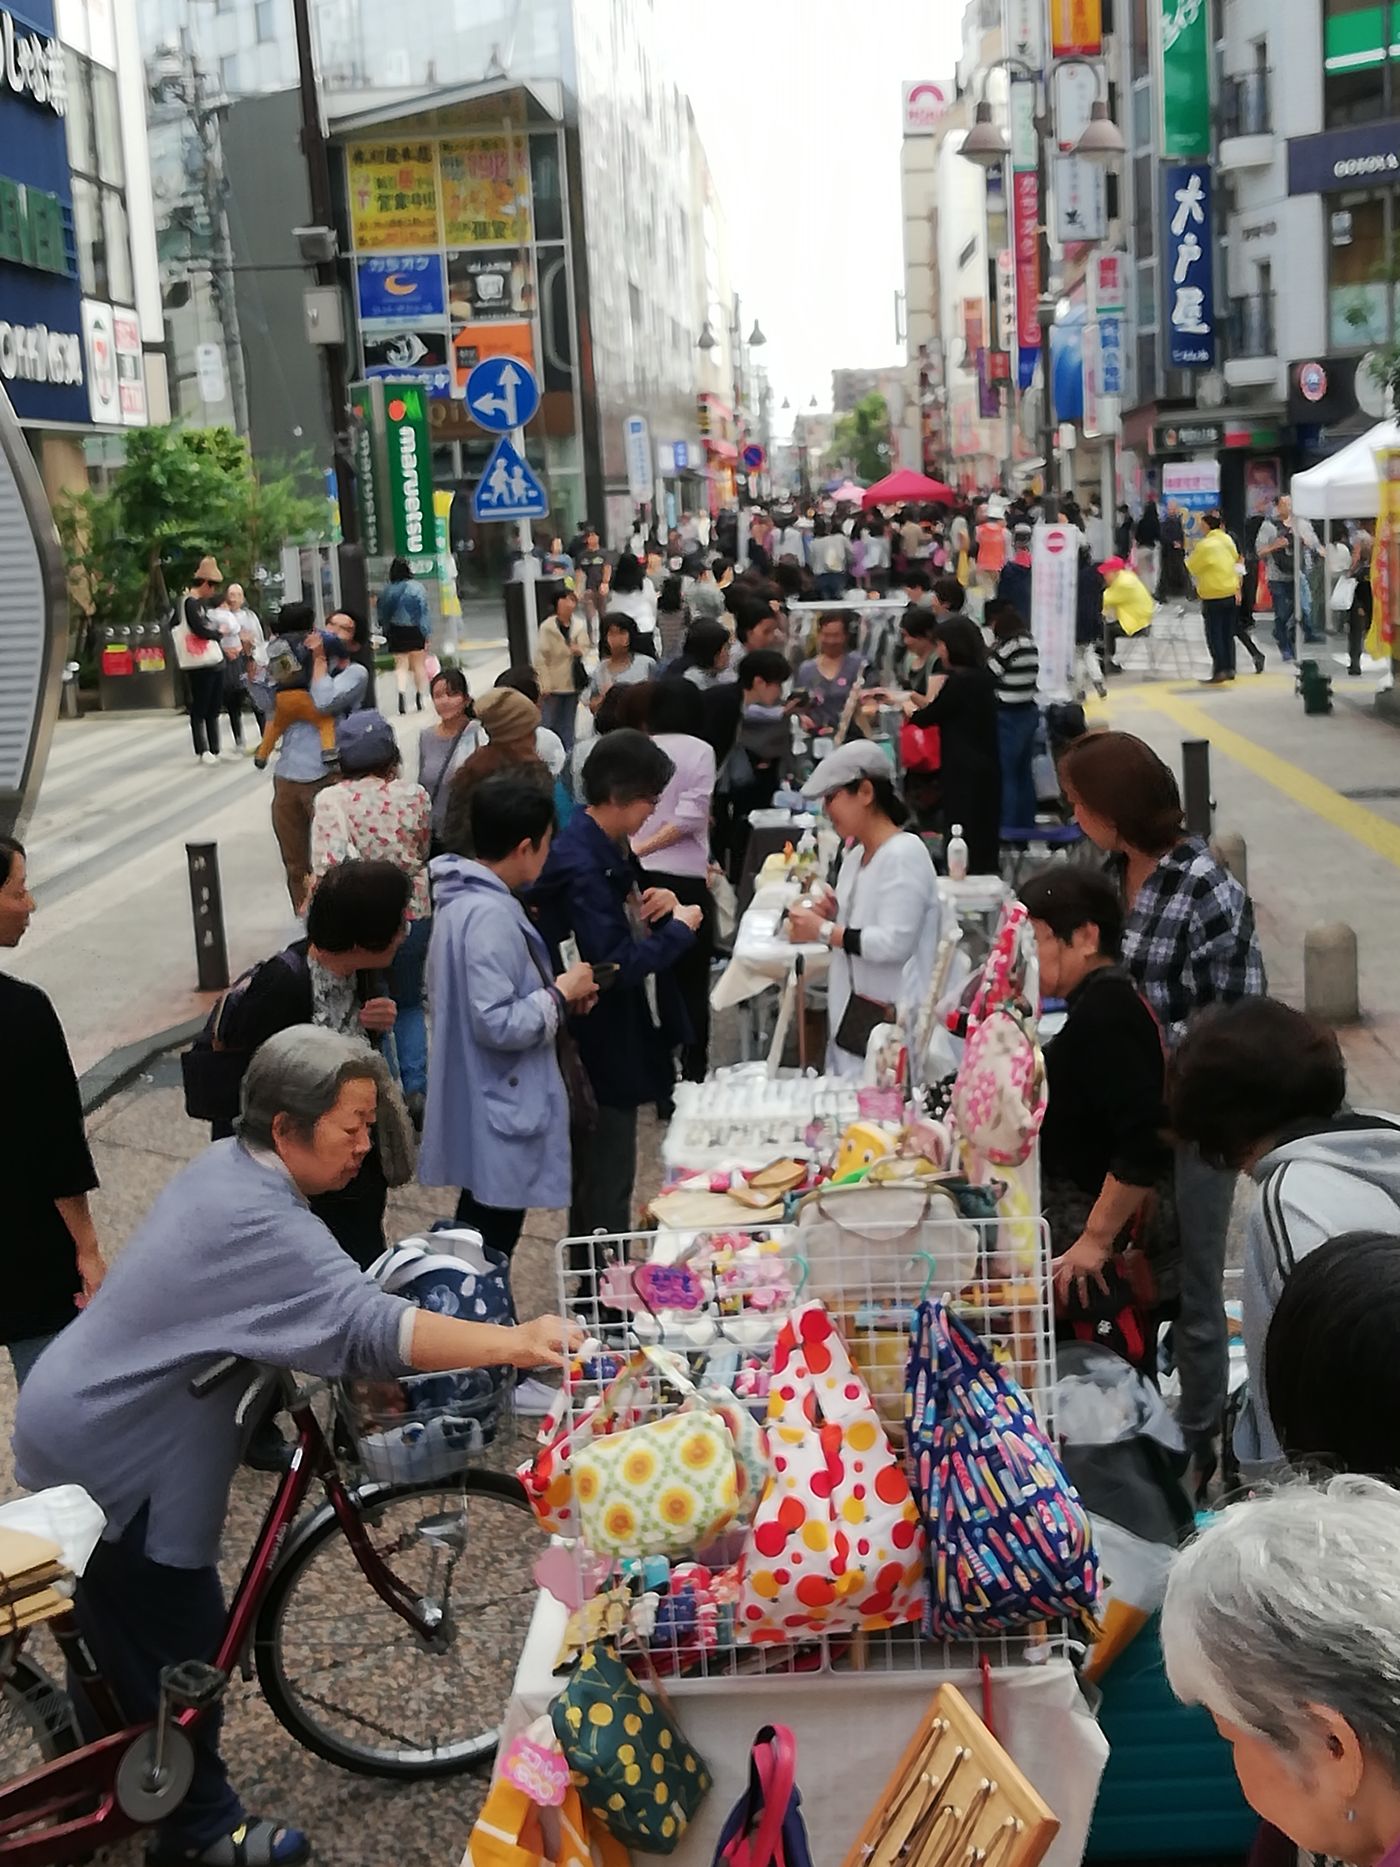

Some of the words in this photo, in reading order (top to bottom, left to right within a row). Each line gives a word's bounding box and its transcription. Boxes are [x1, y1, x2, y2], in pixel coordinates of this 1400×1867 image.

[1170, 173, 1211, 335] 大戸屋
[398, 425, 424, 553] maruetsu
